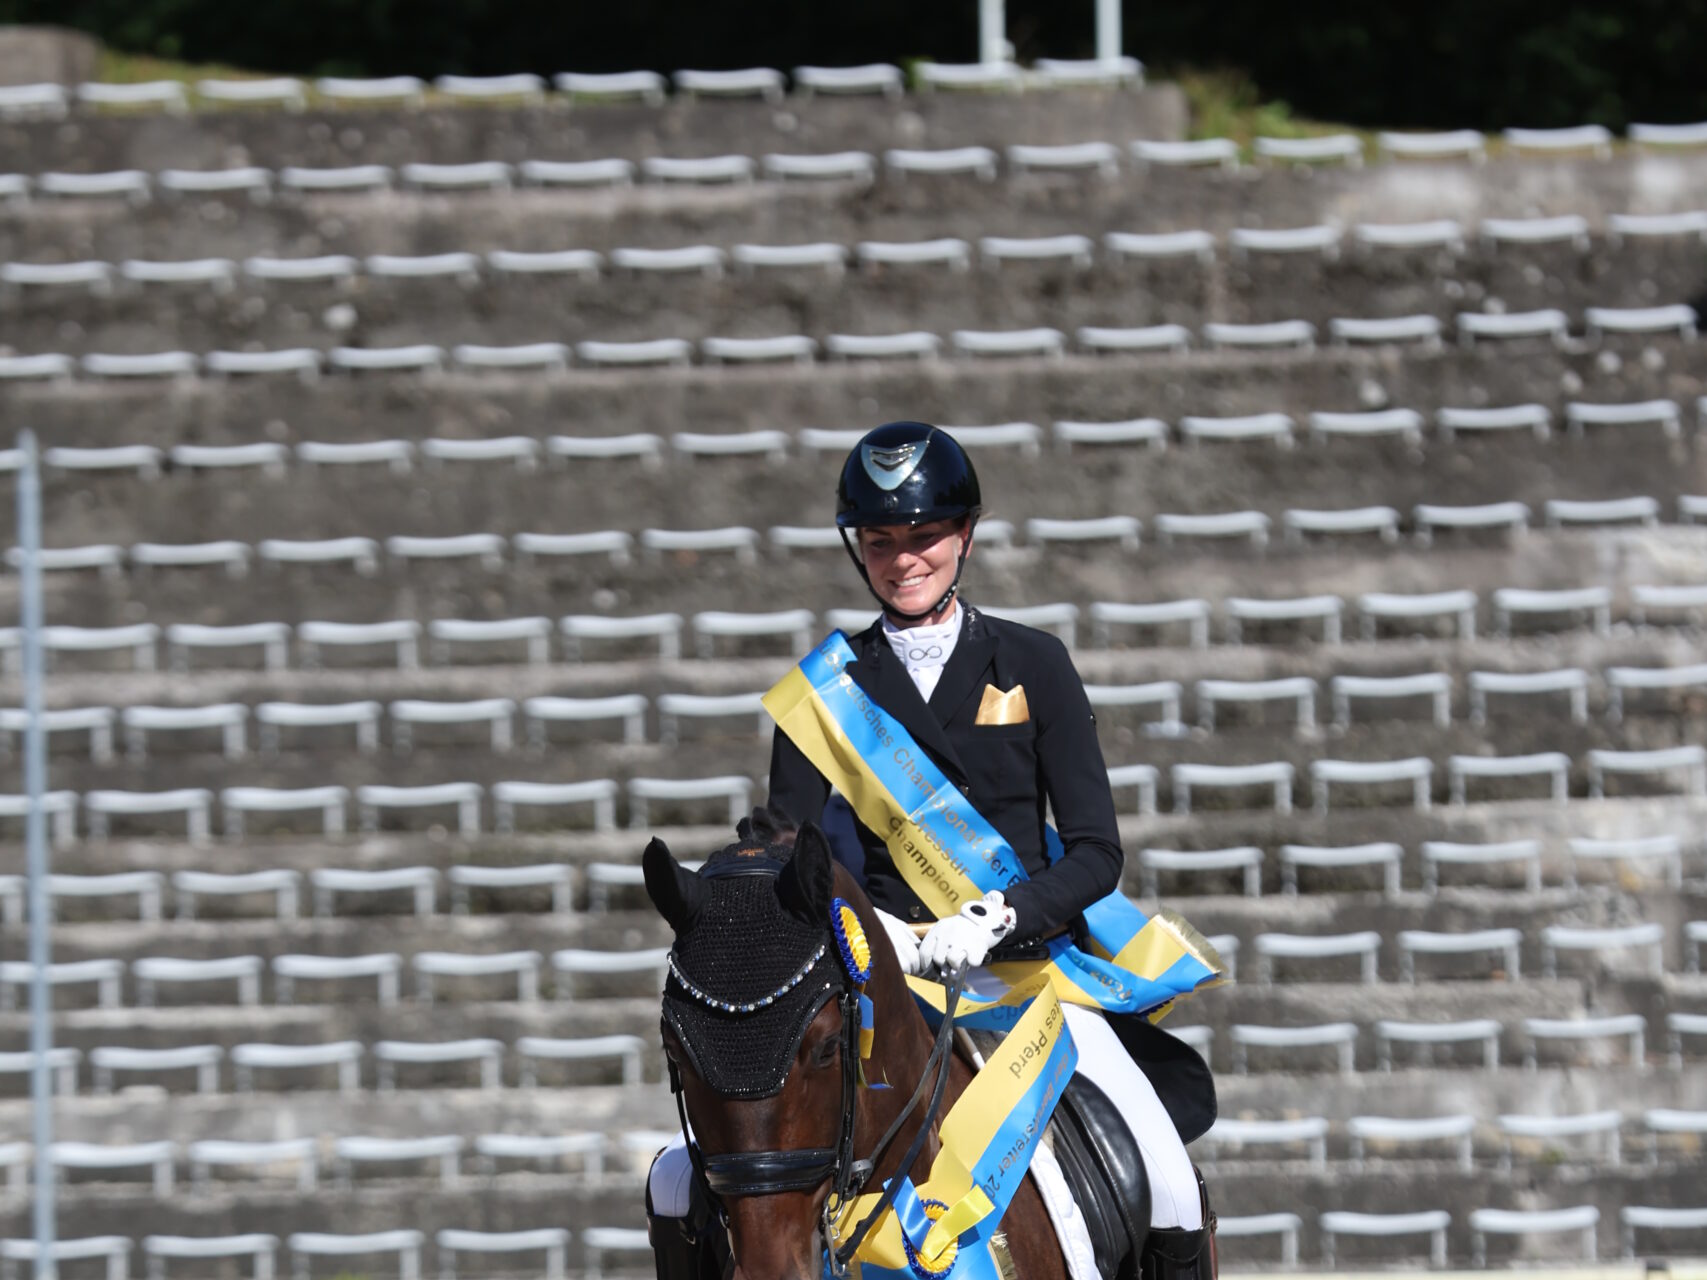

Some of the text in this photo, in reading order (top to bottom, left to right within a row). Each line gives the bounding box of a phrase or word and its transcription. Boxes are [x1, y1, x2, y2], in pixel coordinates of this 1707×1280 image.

[818, 640, 1009, 877] üddeutsches Championat der
[889, 816, 960, 903] Champion
[910, 809, 972, 876] Dressur
[1009, 1029, 1048, 1079] Pferd
